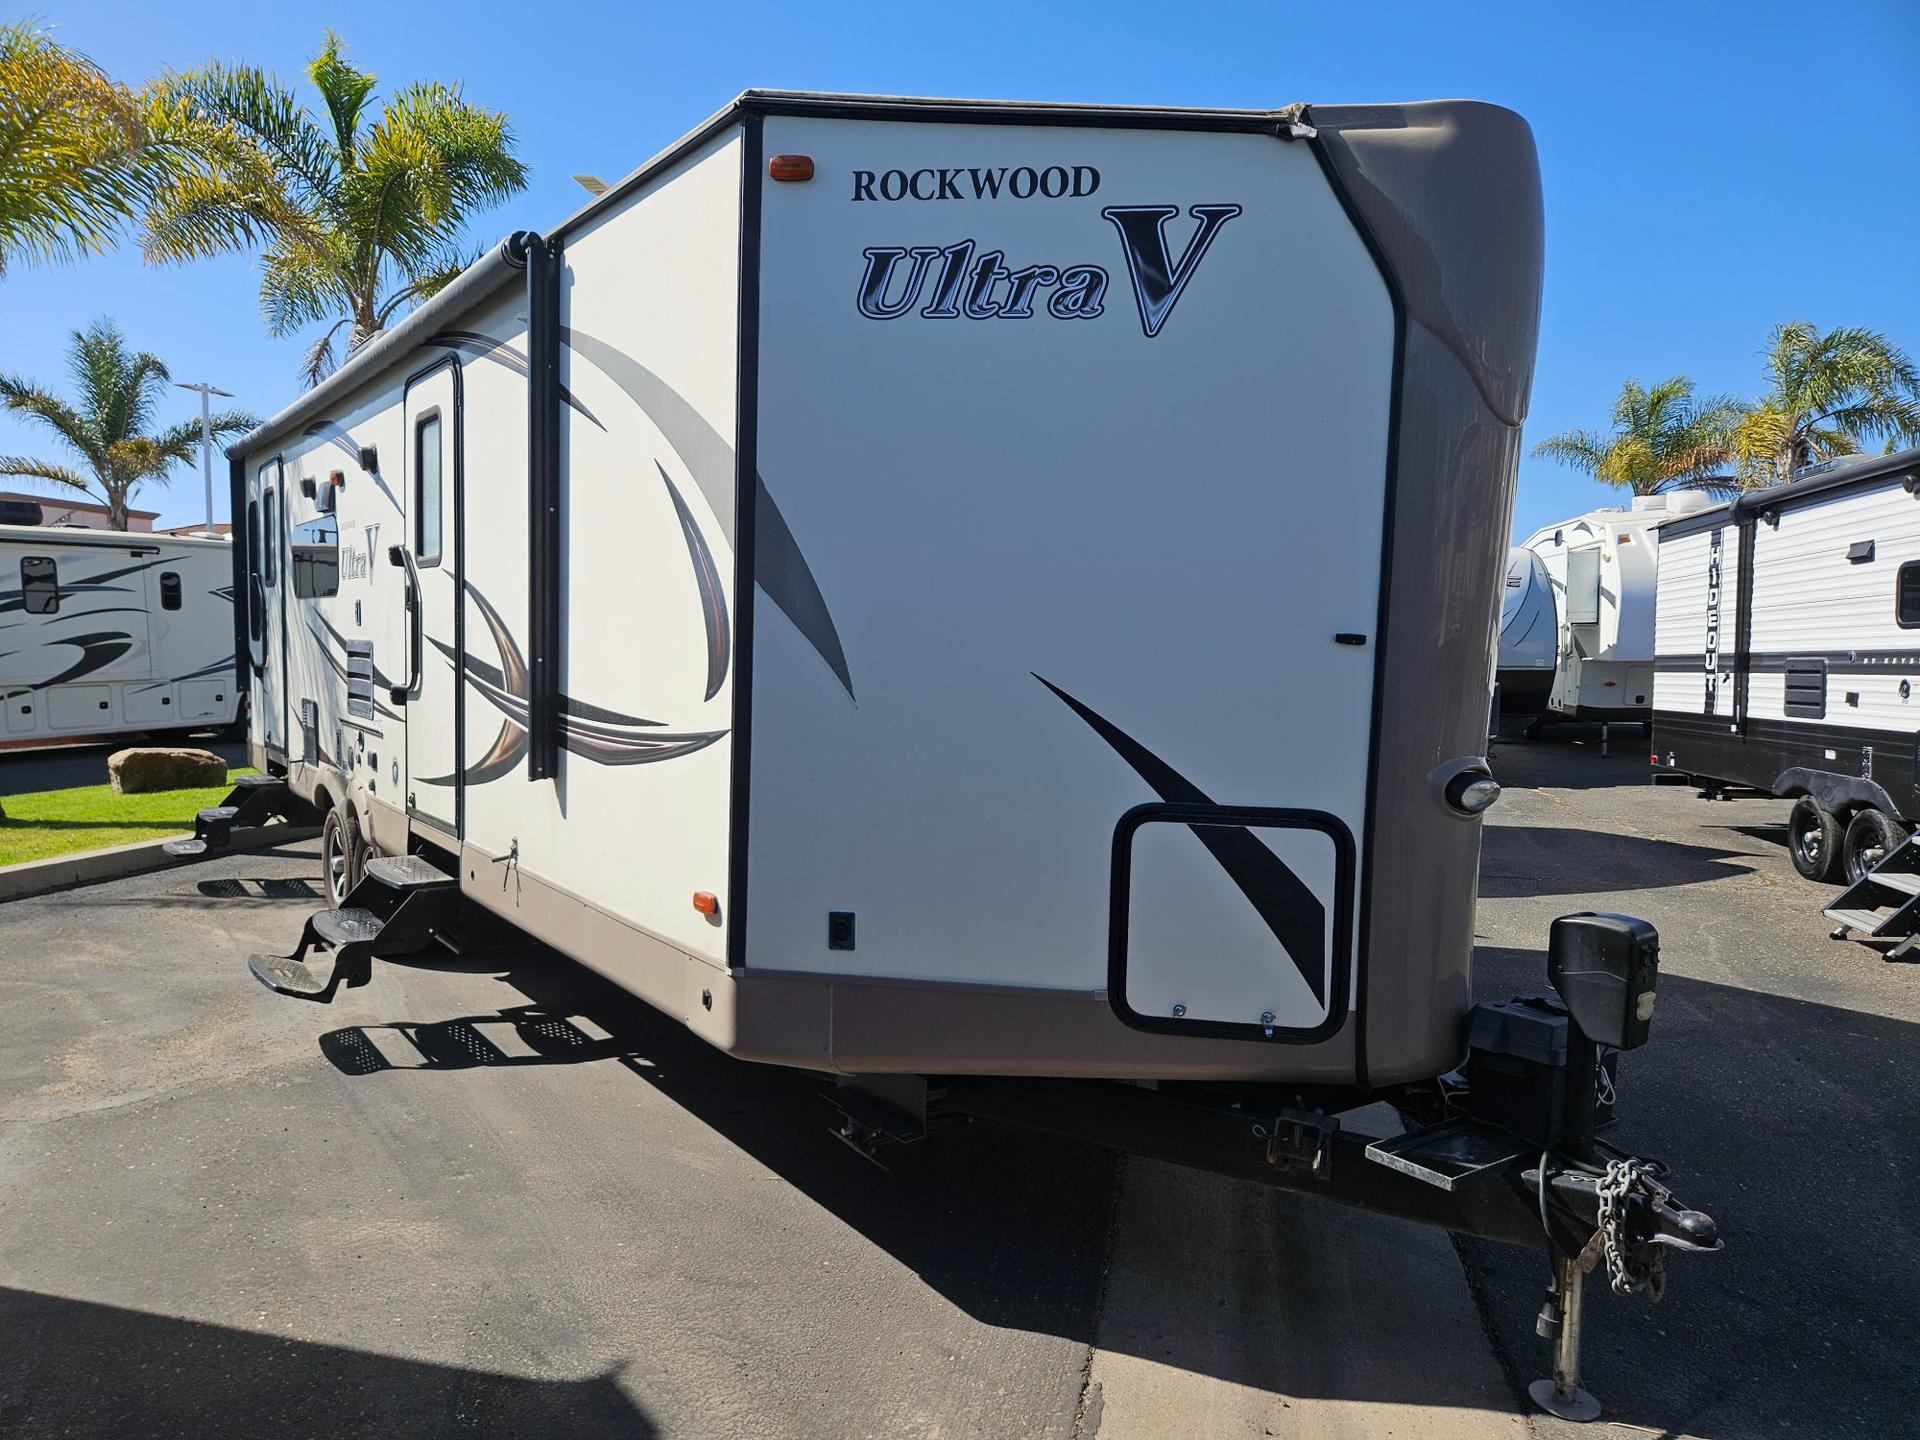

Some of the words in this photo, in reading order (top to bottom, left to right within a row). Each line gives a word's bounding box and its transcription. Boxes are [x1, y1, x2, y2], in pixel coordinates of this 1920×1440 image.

[851, 165, 1101, 201] ROCKWOOD
[857, 238, 1109, 320] Ultra
[1101, 203, 1243, 339] V
[341, 544, 366, 580] Ultra
[364, 523, 380, 587] V
[1705, 545, 1720, 692] HIDEOUT
